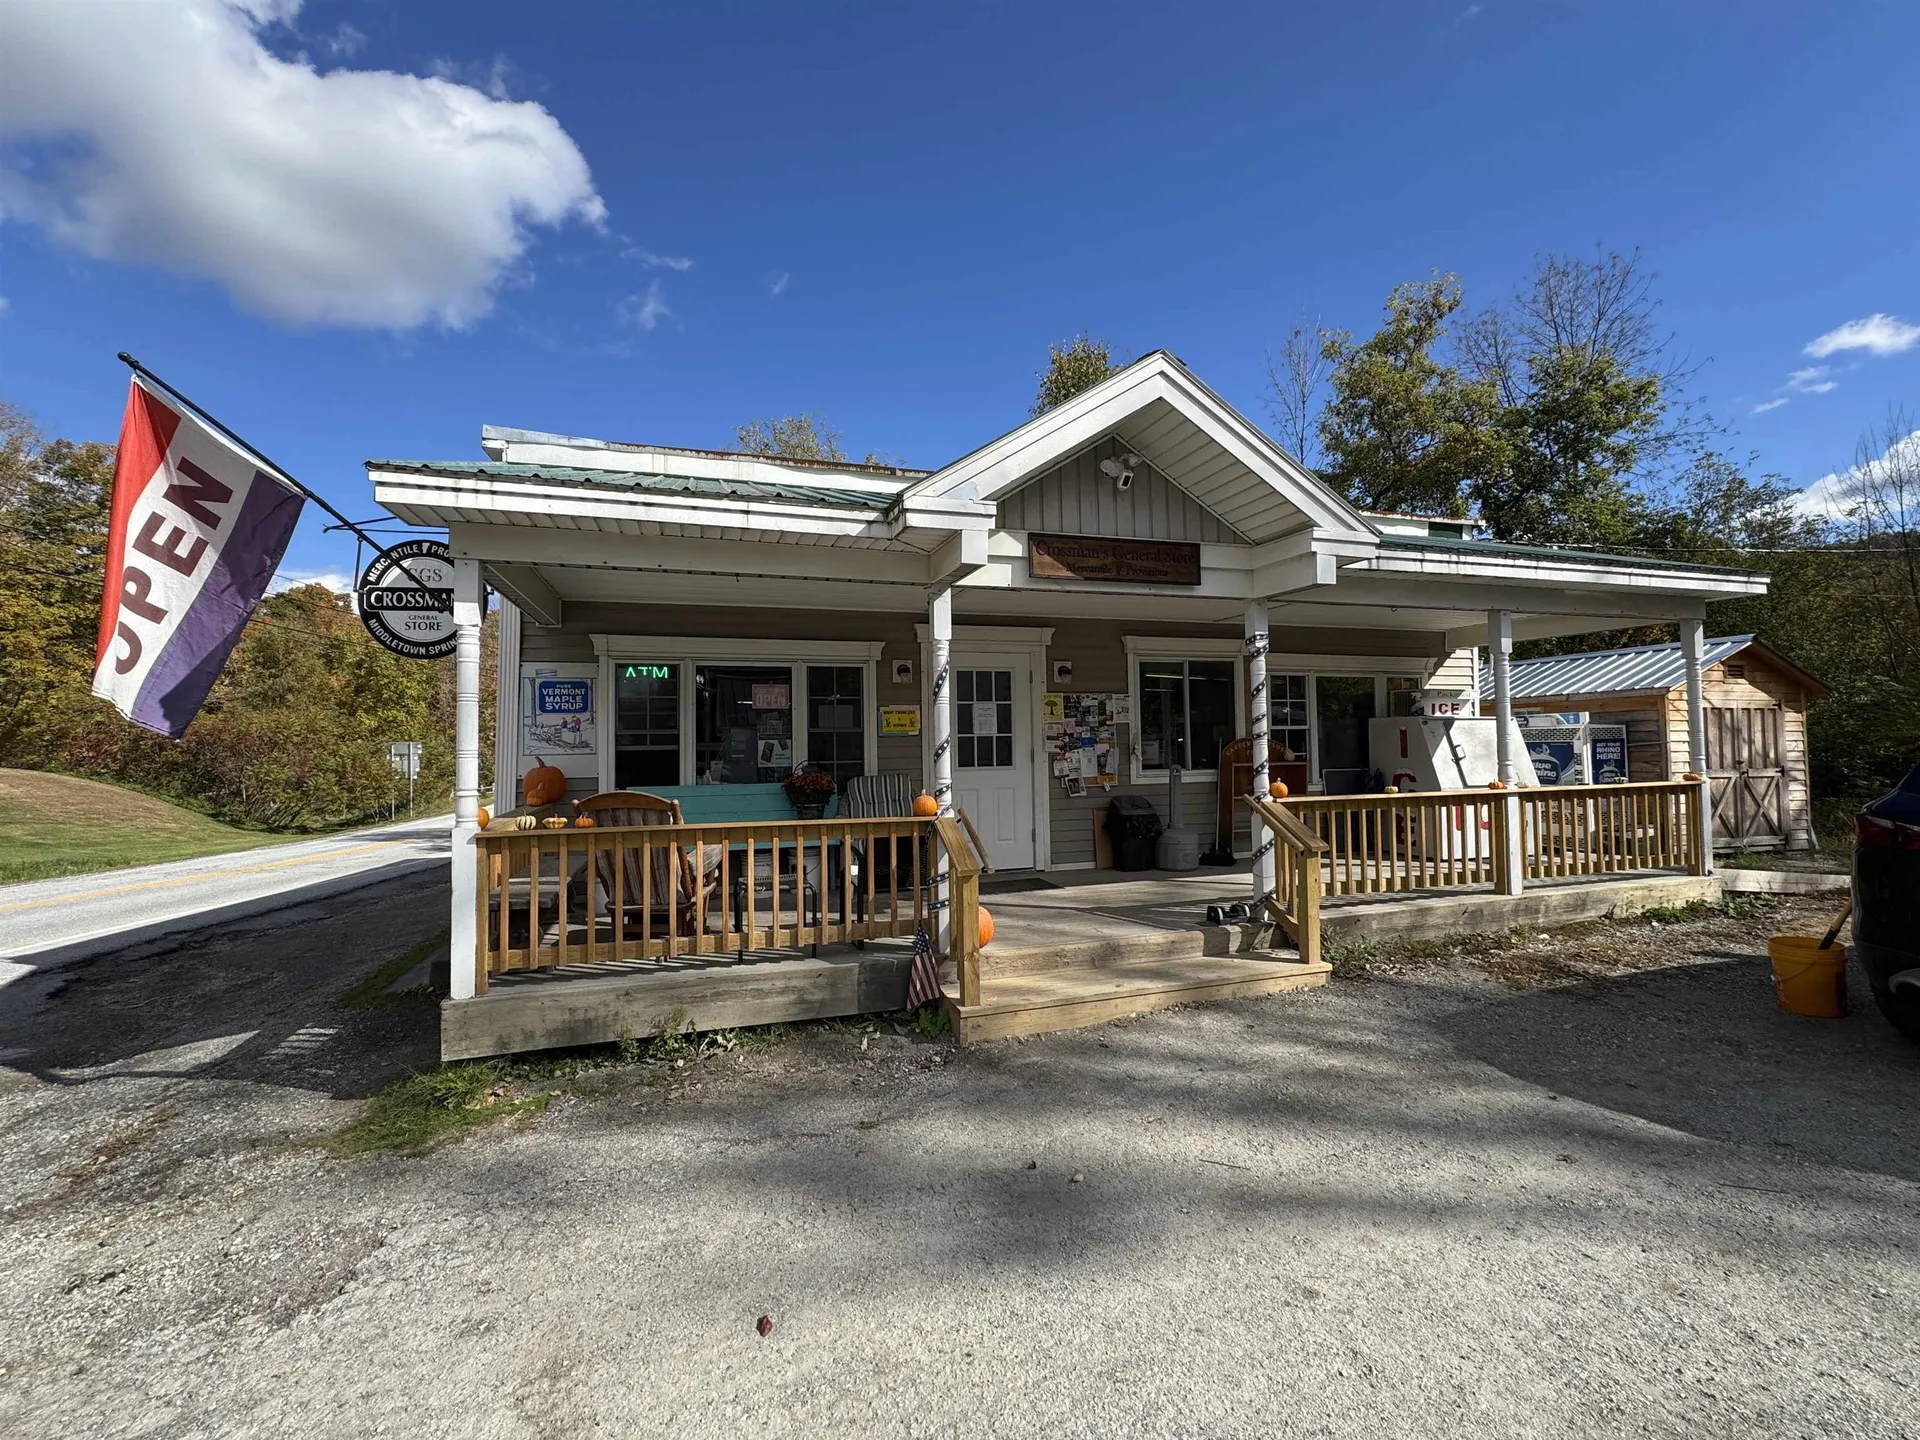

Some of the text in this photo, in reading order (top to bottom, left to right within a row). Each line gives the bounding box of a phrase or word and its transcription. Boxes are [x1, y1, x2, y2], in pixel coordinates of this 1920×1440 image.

[1036, 540, 1196, 565] Crossman's General Store
[366, 544, 420, 582] MERCNTILE
[404, 621, 442, 631] STORE
[368, 618, 426, 655] MIDDLETOWN
[545, 695, 583, 703] MAPLE
[756, 694, 786, 708] OPEN
[545, 702, 583, 711] SYRUP
[1431, 702, 1460, 715] ICE
